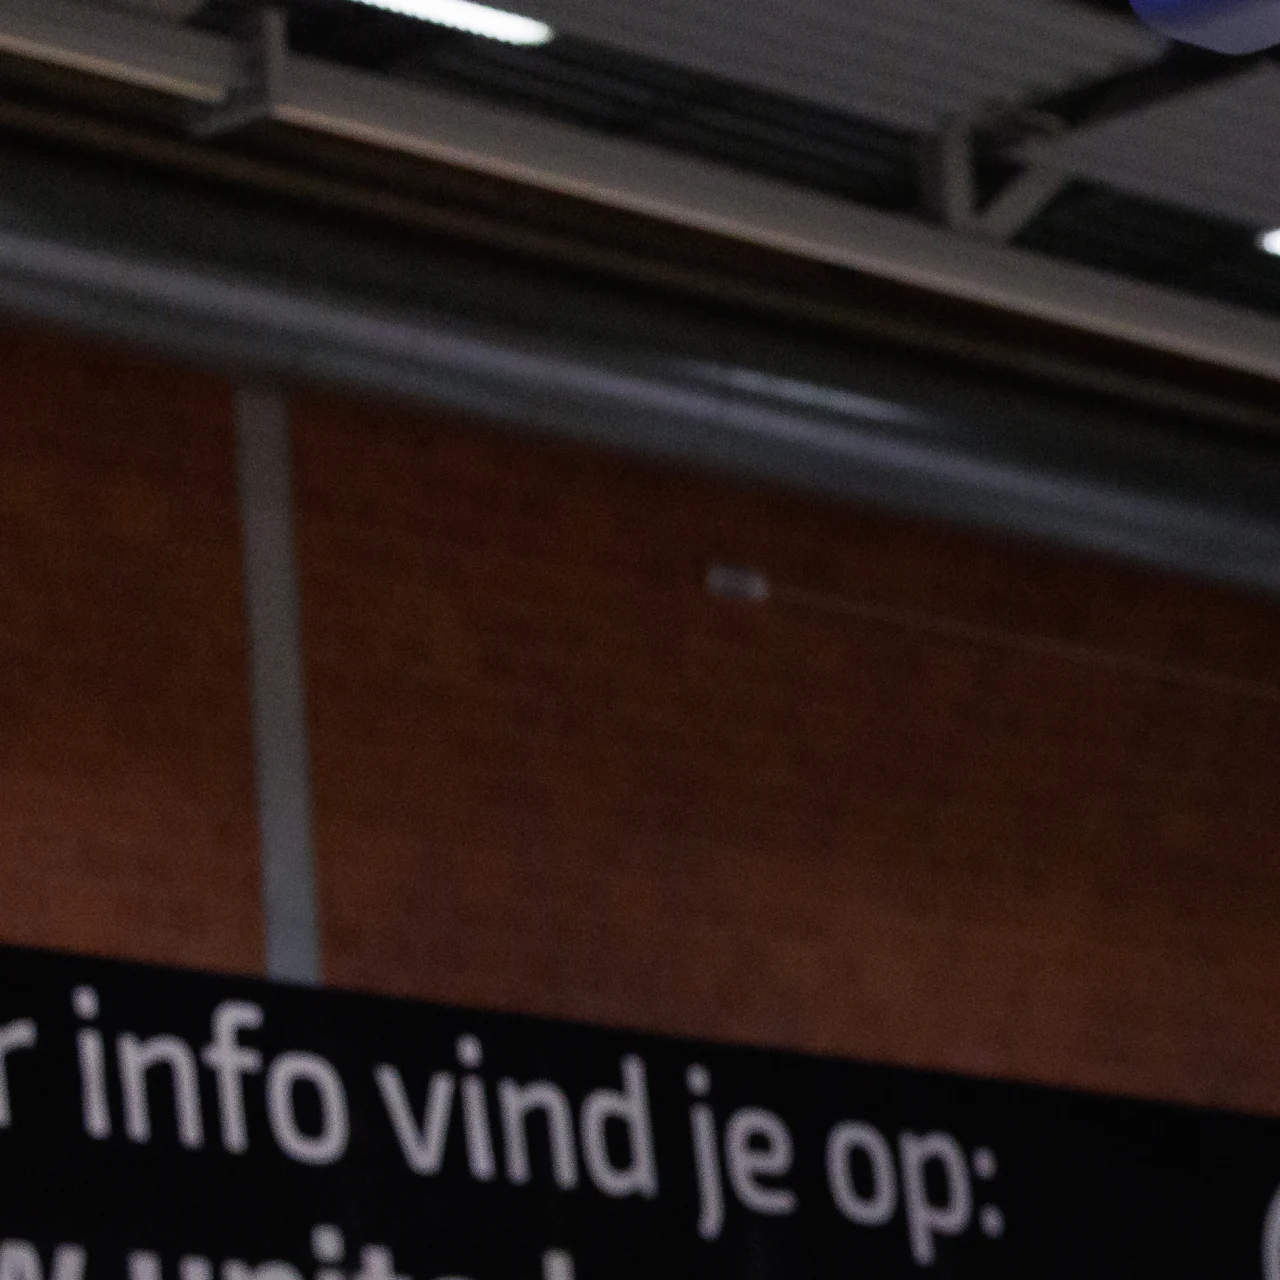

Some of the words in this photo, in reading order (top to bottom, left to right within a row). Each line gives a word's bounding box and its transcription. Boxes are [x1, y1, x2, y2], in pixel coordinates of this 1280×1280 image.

[72, 985, 349, 1166] info
[374, 1034, 659, 1199] vind
[686, 1065, 797, 1241] je
[824, 1120, 1003, 1266] op:
